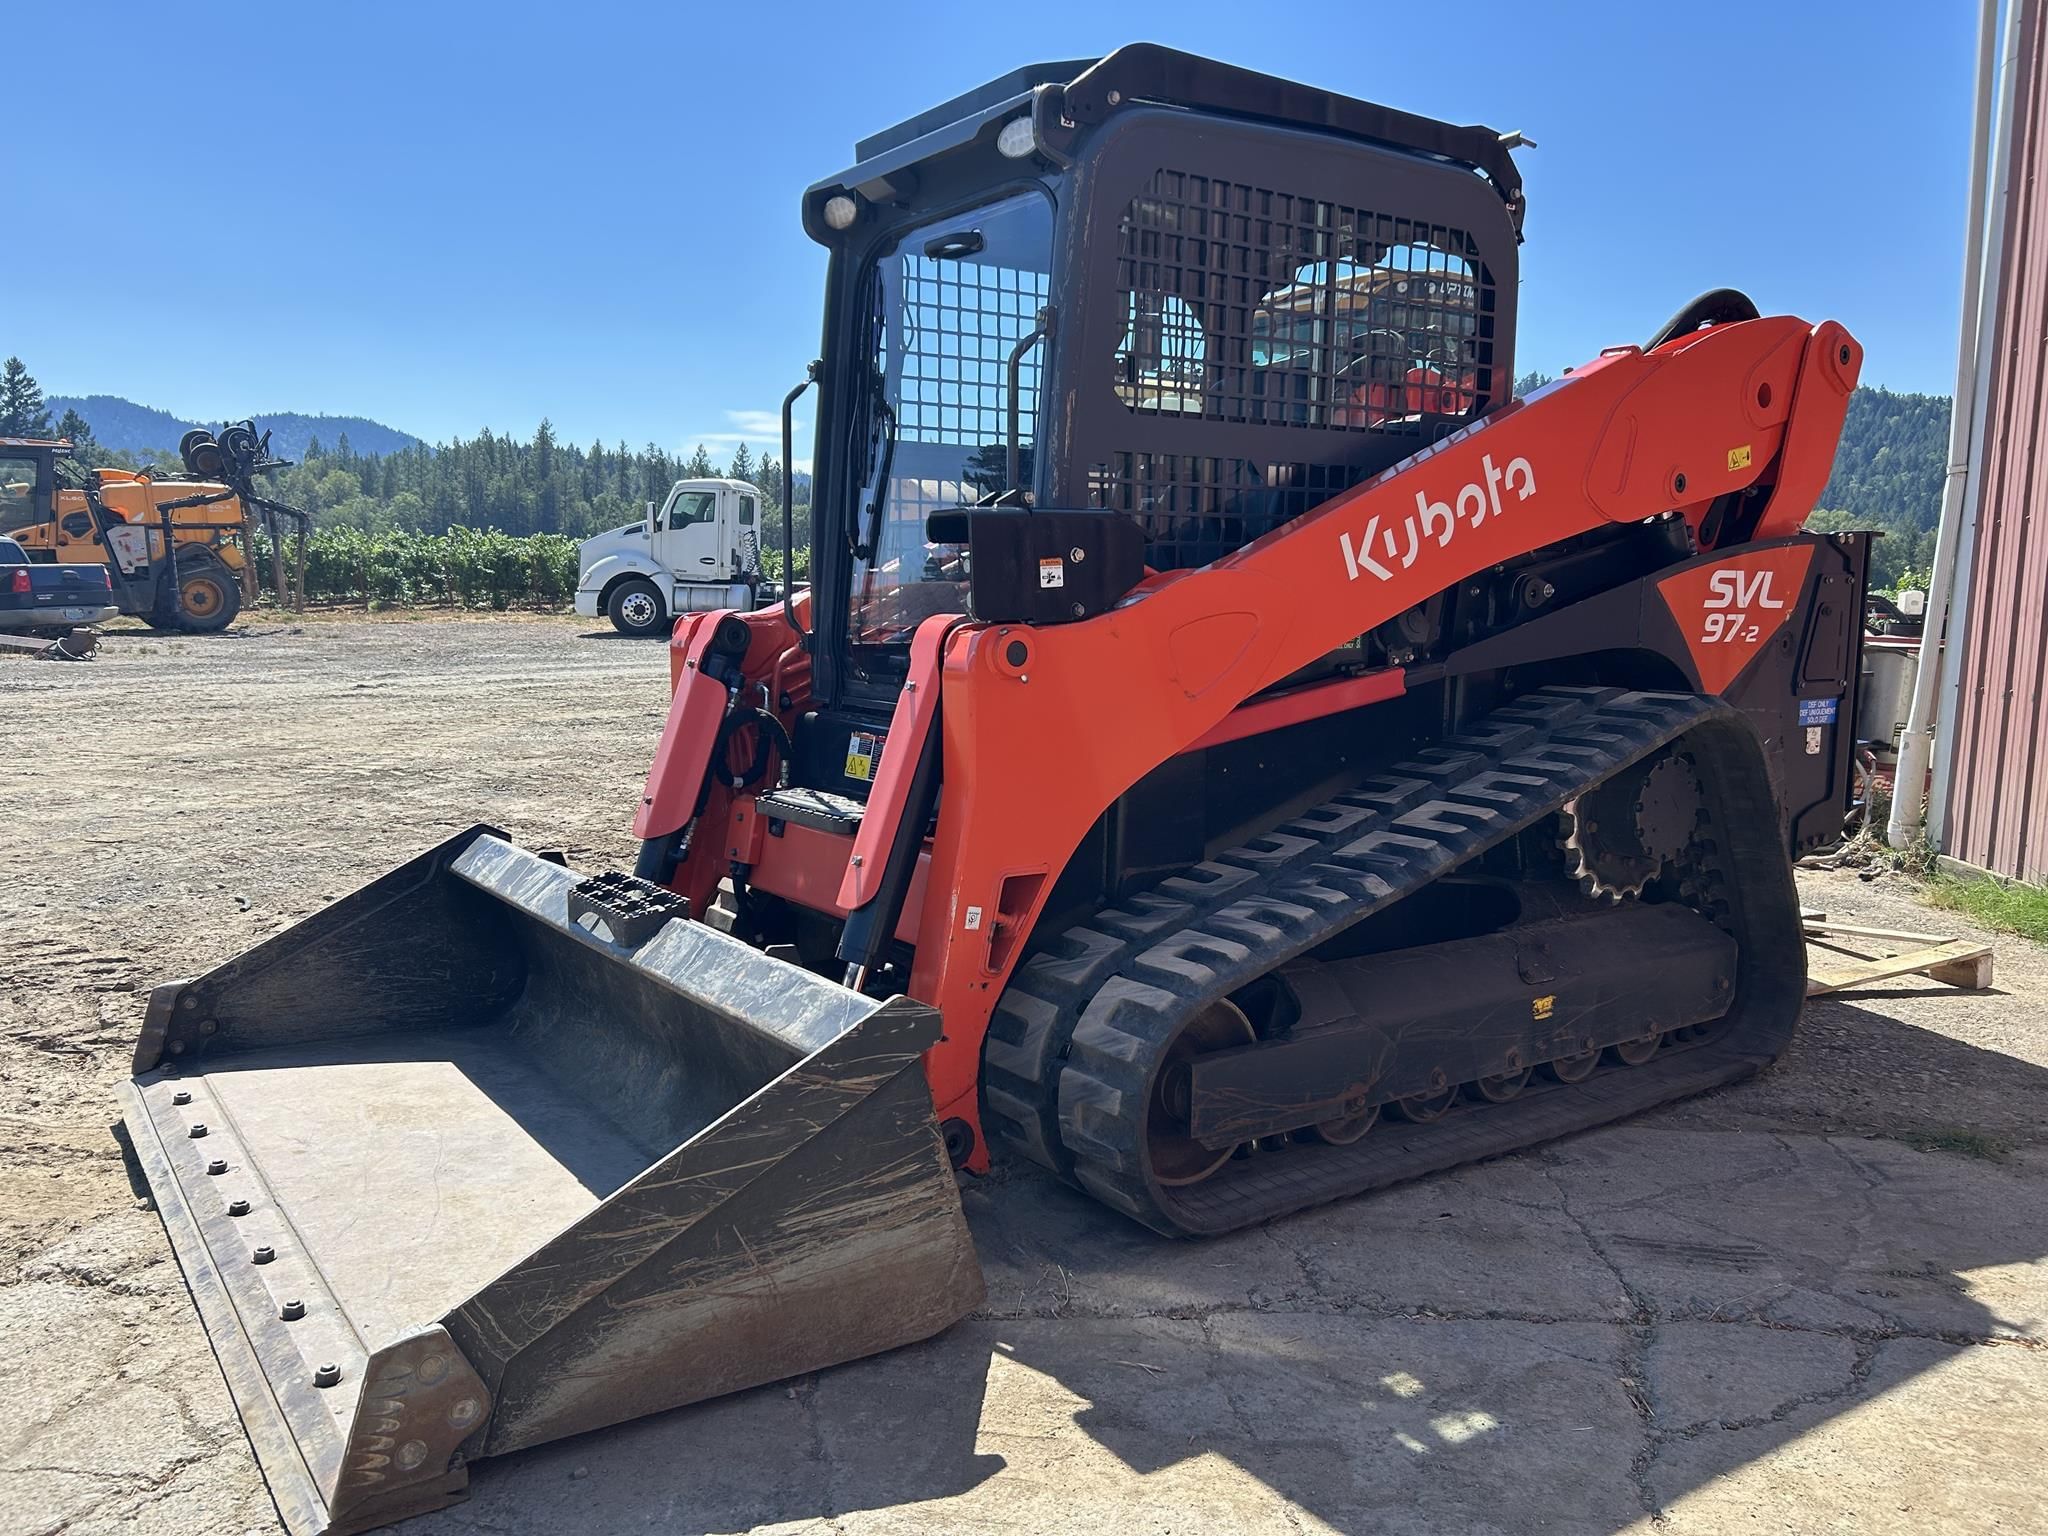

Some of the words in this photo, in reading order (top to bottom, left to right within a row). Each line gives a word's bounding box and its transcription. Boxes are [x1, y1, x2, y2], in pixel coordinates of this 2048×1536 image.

[1339, 453, 1537, 582] Kubota
[1703, 569, 1784, 609] SVL
[1701, 613, 1760, 643] 97-2
[1799, 709, 1808, 717] DEF
